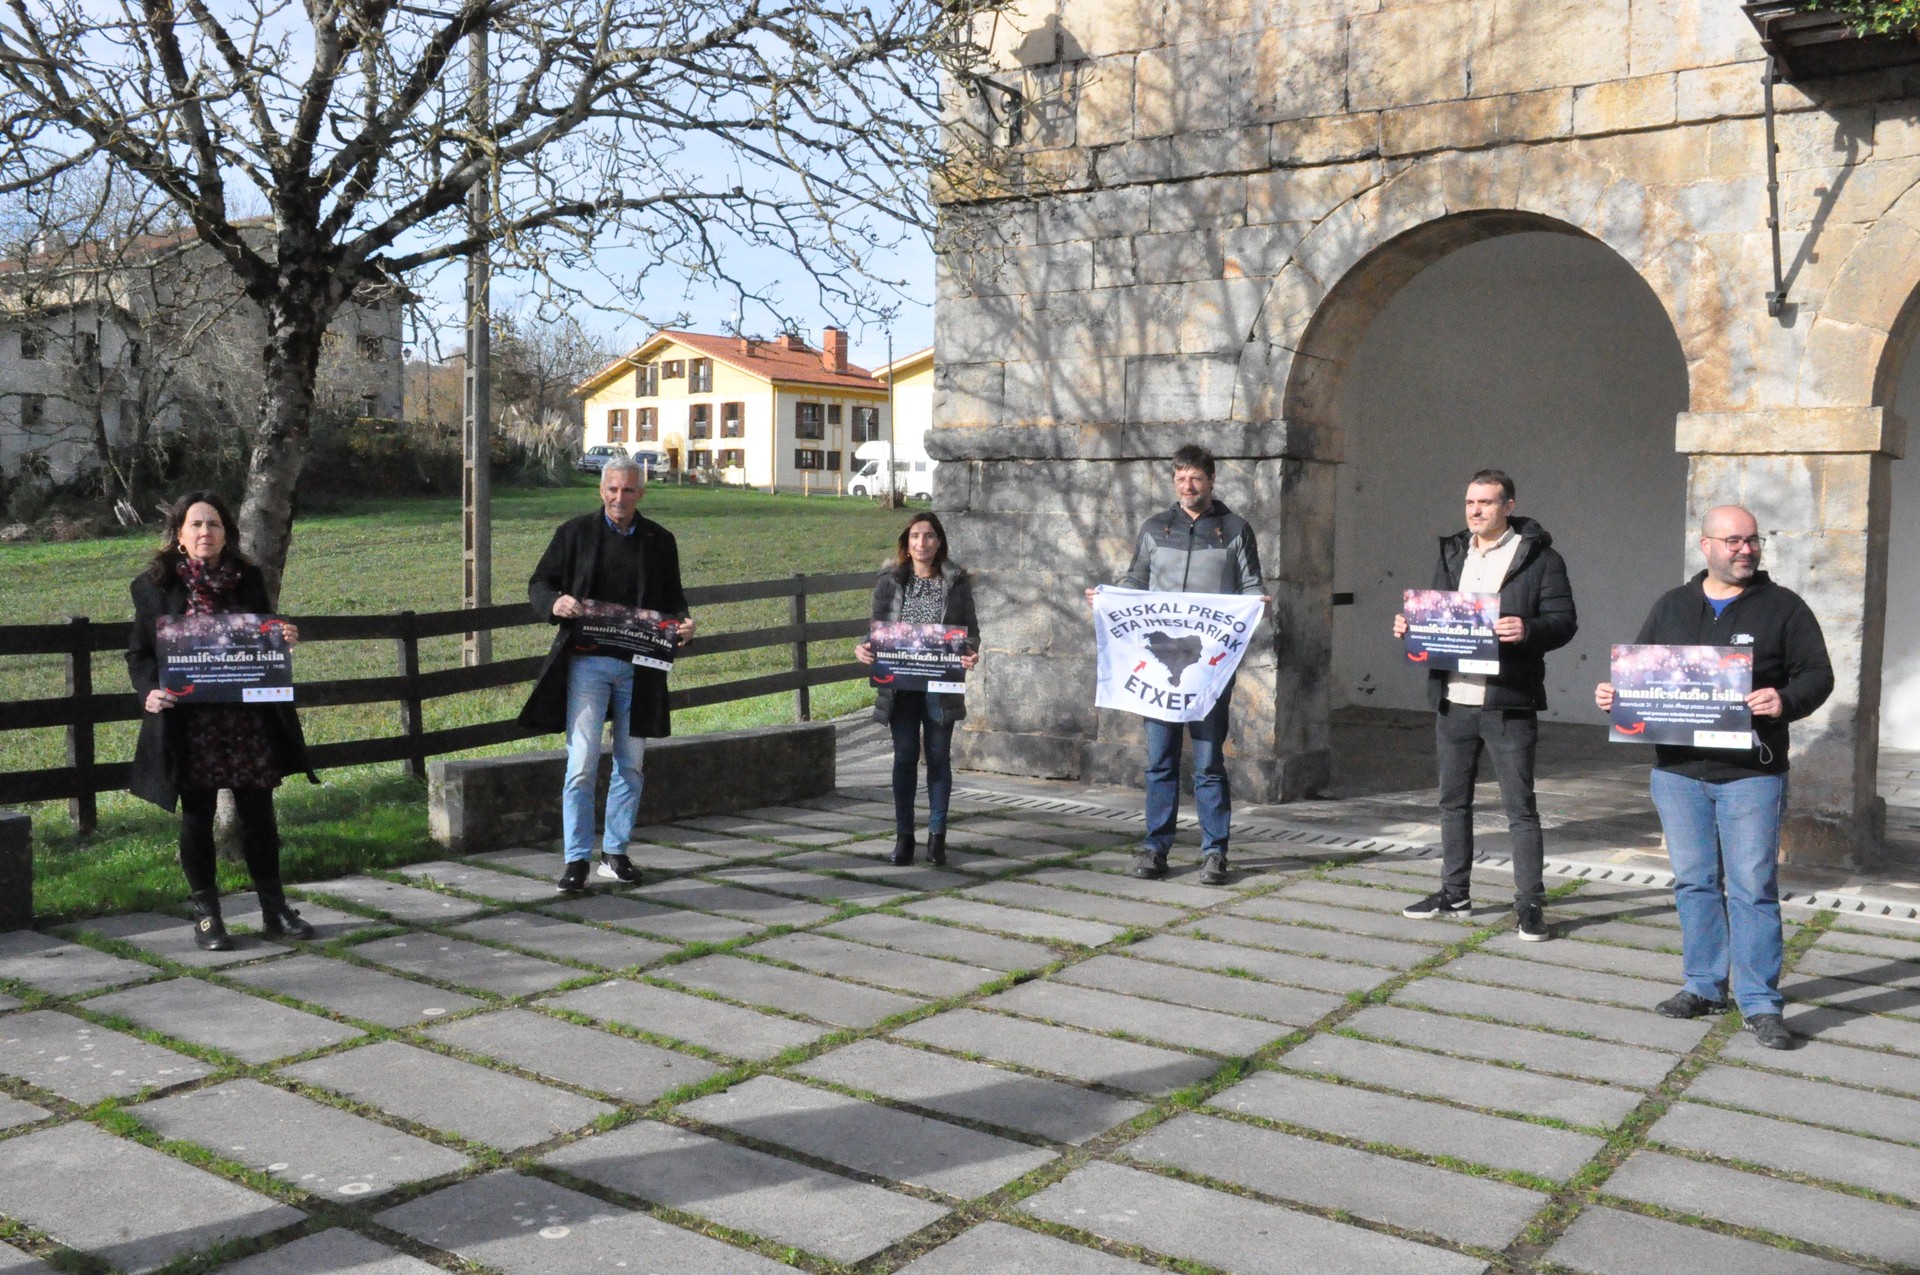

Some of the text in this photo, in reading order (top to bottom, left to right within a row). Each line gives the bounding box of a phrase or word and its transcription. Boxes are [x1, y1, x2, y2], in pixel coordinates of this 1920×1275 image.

[1108, 602, 1246, 634] EUSKAL PRESO
[583, 625, 649, 641] manifestazio
[651, 635, 672, 648] isila
[1110, 618, 1243, 652] ETA IHESLARIAK
[1410, 624, 1493, 636] manifestazio isila
[167, 650, 284, 663] manifestazio isila
[876, 651, 961, 662] manifestazio isila
[1619, 687, 1743, 702] manifestazio isila
